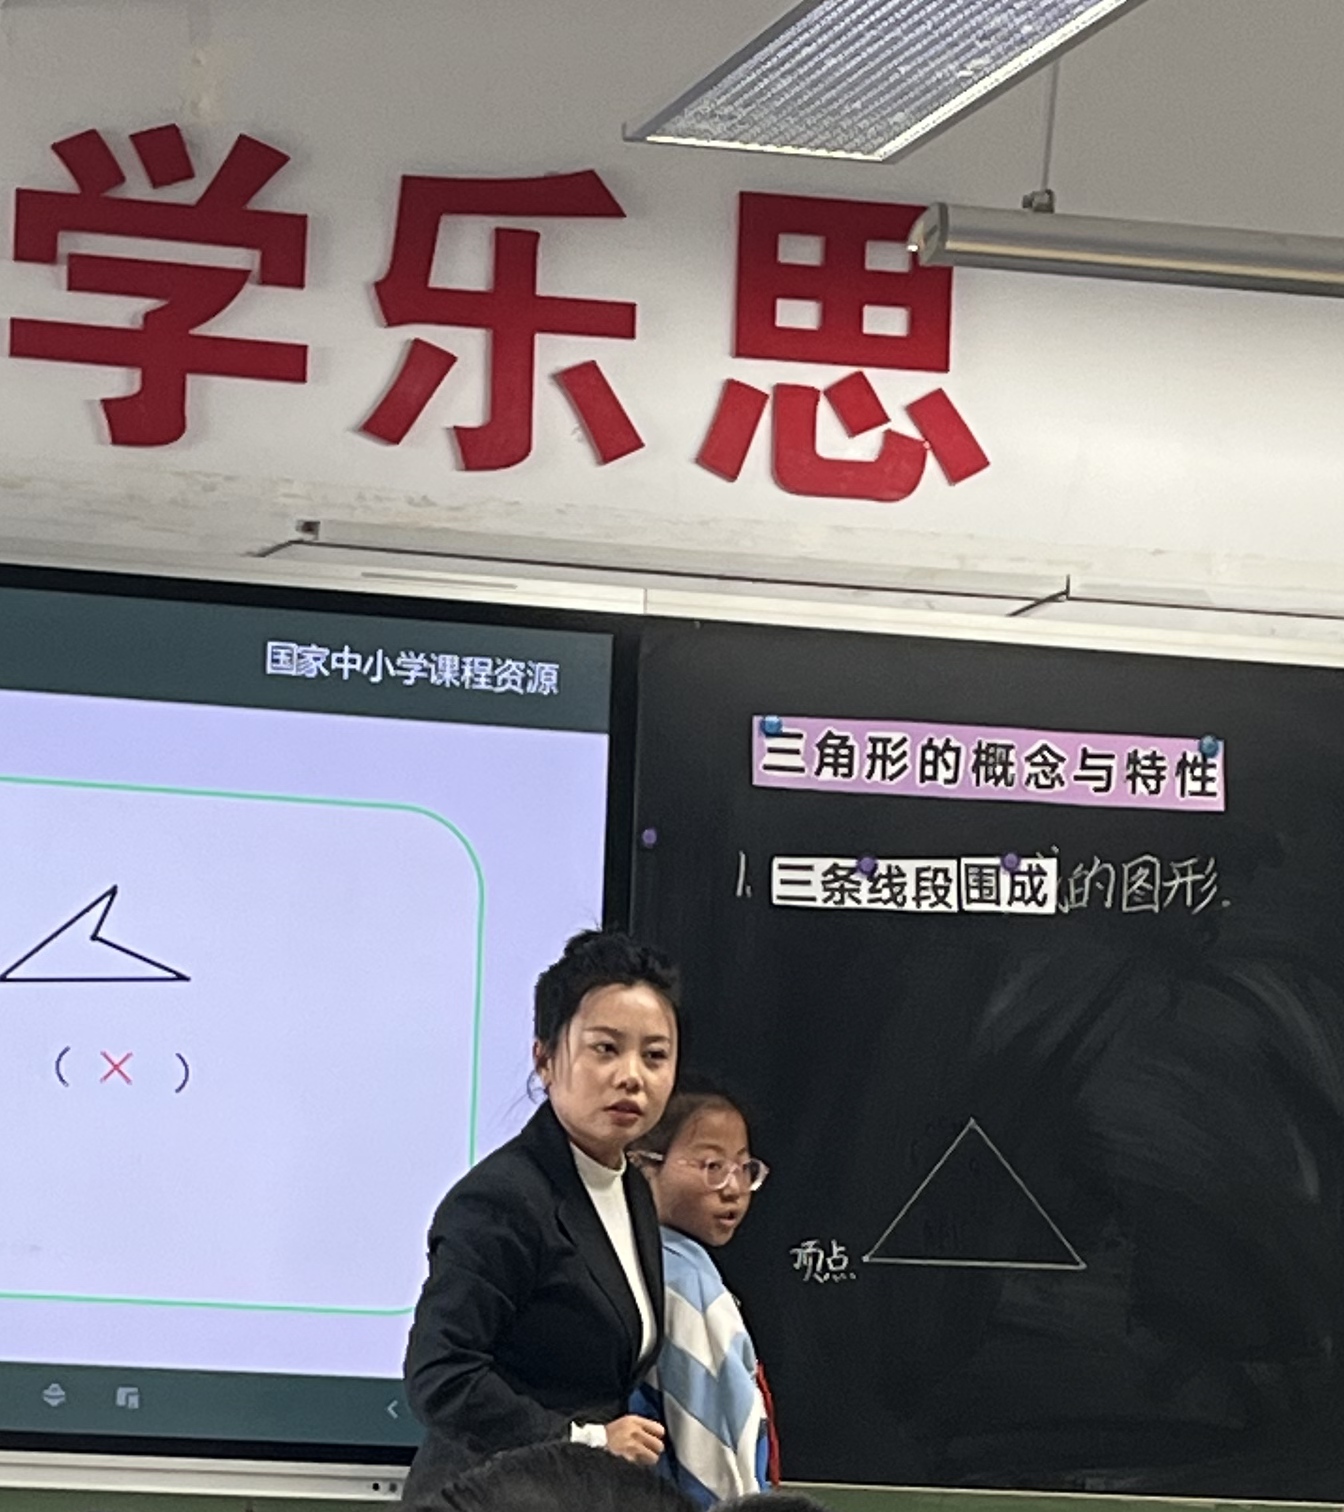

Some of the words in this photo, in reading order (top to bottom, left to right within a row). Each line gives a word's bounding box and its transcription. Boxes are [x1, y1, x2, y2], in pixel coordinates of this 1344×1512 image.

[266, 642, 559, 695] 国家中小学课程资源
[762, 729, 1218, 798] 三角形的概念与特性
[789, 1239, 856, 1283] 顶点
